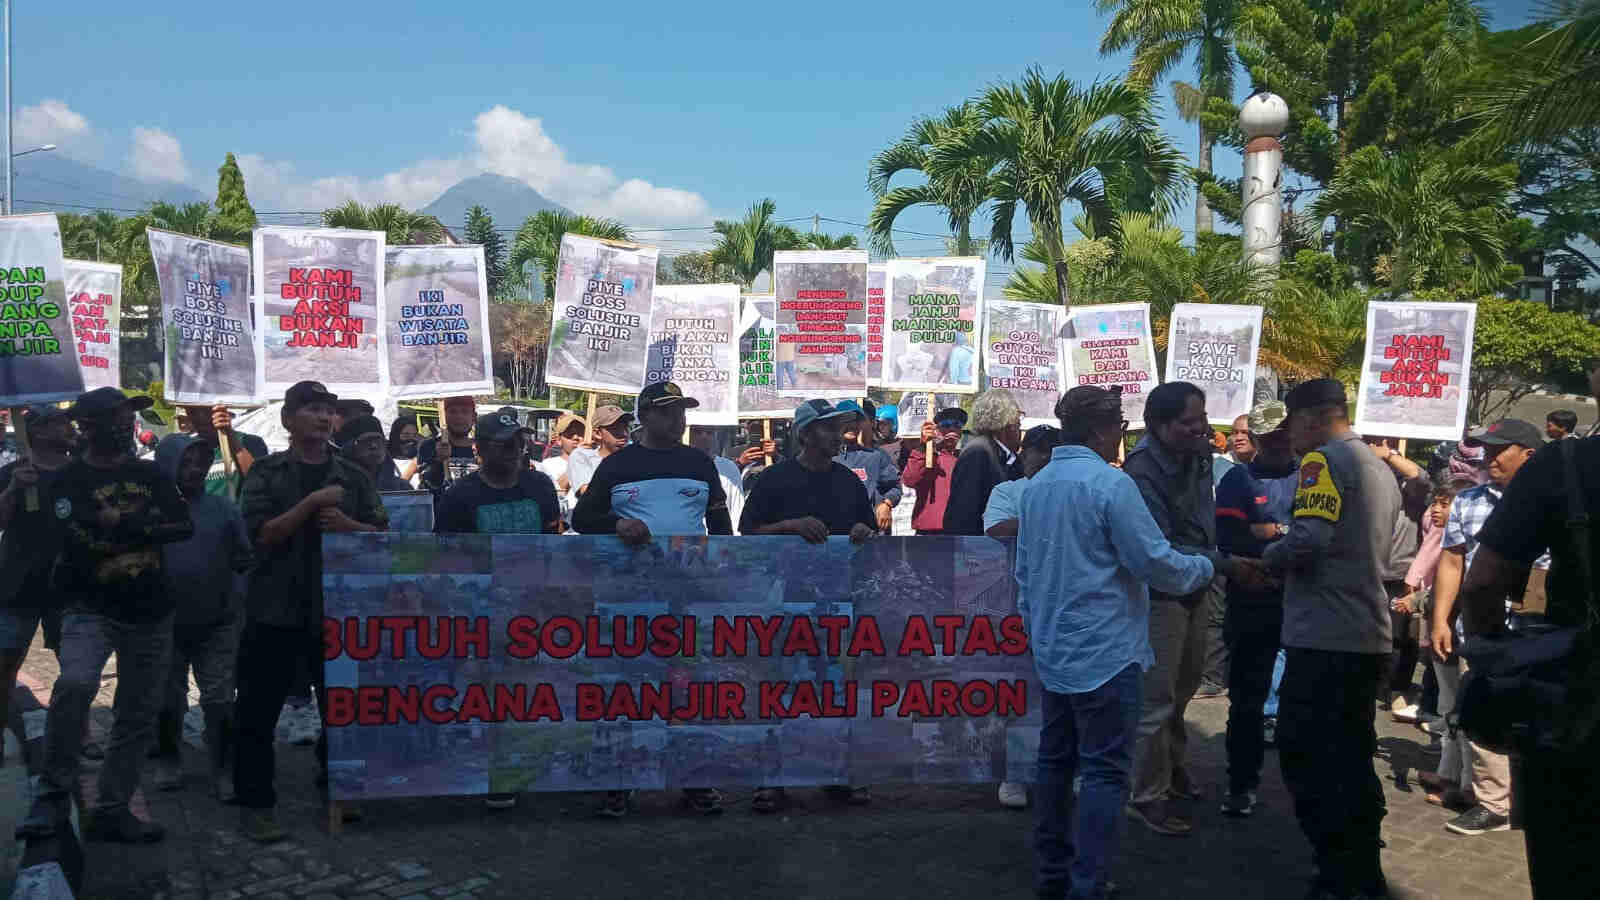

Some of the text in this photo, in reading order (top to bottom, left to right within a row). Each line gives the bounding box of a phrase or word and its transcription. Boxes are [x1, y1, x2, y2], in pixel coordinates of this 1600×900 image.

[289, 268, 352, 284] KAMI
[186, 280, 222, 299] PIYE
[281, 284, 361, 301] BUTUH
[588, 279, 624, 296] PIYE
[419, 290, 444, 303] IKI
[583, 292, 626, 311] BOSS
[909, 294, 961, 305] MANA
[185, 295, 226, 315] BOSS
[294, 301, 350, 316] AKSI
[401, 304, 463, 318] BUKAN
[909, 306, 960, 318] JANJI
[172, 308, 242, 332] SOLUSINE
[566, 305, 640, 328] SOLUSINE
[280, 316, 363, 333] BUKAN
[399, 318, 469, 331] WISATA
[571, 320, 631, 341] BANJIR
[664, 319, 715, 329] BUTUH
[892, 319, 973, 332] MANISMU
[182, 326, 239, 346] BANJIR
[287, 332, 358, 349] JANJI
[401, 332, 468, 346] BANJIR
[911, 331, 955, 343] DULU
[1009, 330, 1040, 342] OJO
[1392, 335, 1444, 346] KAMI
[588, 337, 609, 351] IKI
[661, 344, 713, 355] BUKAN
[1188, 342, 1238, 356] SAVE
[1090, 348, 1128, 360] KAMI
[1384, 346, 1450, 360] BUTUH
[663, 357, 715, 369] HANYA
[999, 354, 1049, 367] BANJIR
[1095, 360, 1129, 371] DARI
[1190, 355, 1233, 368] KALI
[1392, 360, 1438, 372] AKSI
[647, 370, 729, 382] OMONGAN
[1014, 367, 1036, 377] IKU
[1079, 370, 1148, 385] BENCANA
[1178, 367, 1243, 382] PARON
[1380, 371, 1448, 385] BUKAN
[992, 377, 1056, 391] BENCANA
[1384, 384, 1441, 398] JANJI
[322, 614, 1028, 659] BUTUH SOLUSI NYATA ATAS
[326, 680, 1028, 726] BENCANA BANJIR KALI PARON
